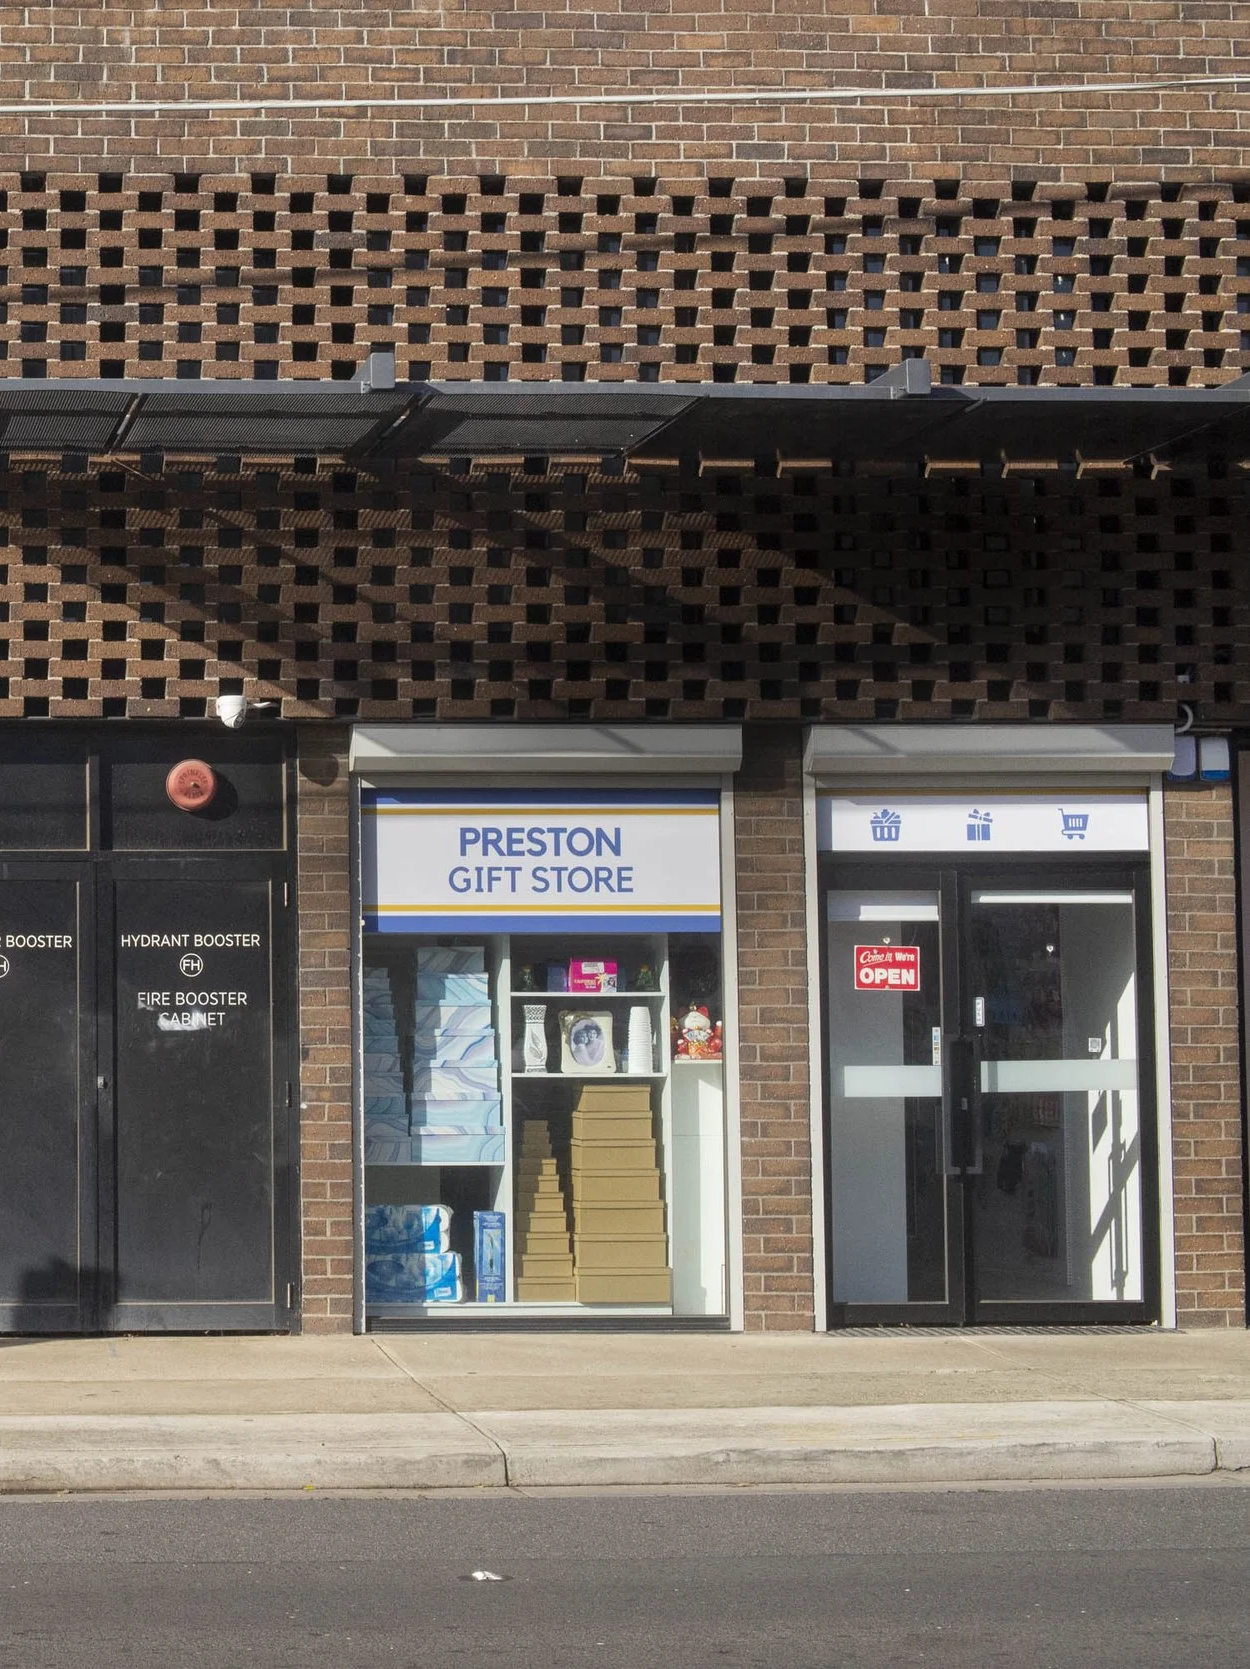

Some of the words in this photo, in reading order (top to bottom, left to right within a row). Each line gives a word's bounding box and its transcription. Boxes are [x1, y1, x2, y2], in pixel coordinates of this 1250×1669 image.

[459, 827, 621, 857] PRESTON
[449, 866, 522, 893] GIFT
[531, 866, 634, 893] STORE
[6, 934, 73, 948] BOOSTER
[121, 934, 190, 947] HYDRANT
[194, 934, 261, 947] BOOSTER
[860, 950, 884, 964] Come
[895, 952, 915, 962] We're
[182, 959, 201, 971] FH
[859, 967, 915, 985] OPEN
[137, 992, 171, 1006] FIRE
[175, 992, 248, 1006] BOOSTER
[159, 1012, 226, 1026] CABINET
